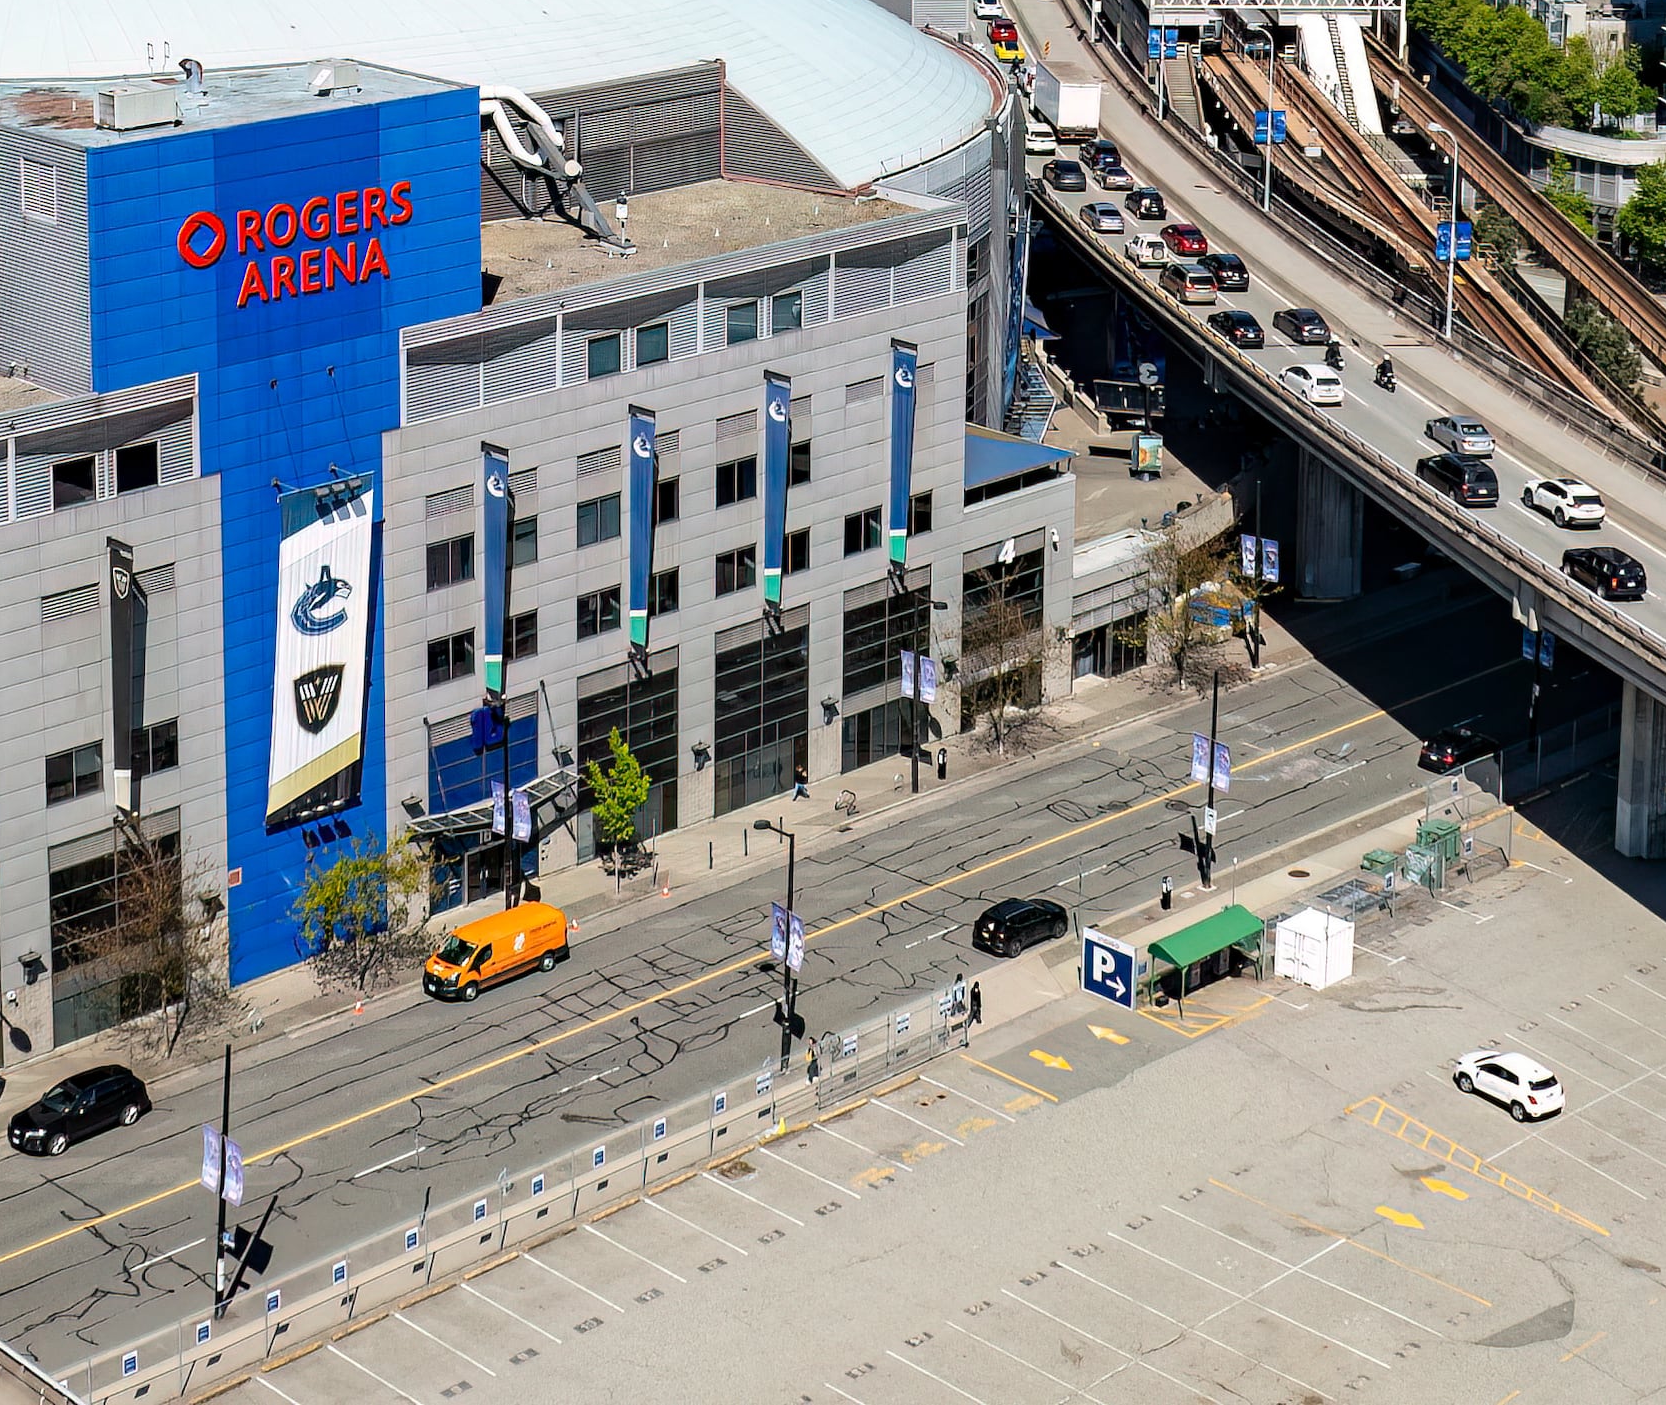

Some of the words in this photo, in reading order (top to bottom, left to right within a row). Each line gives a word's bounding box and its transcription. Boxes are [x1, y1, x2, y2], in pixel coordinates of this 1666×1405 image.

[235, 179, 414, 255] ROGERS
[235, 237, 391, 308] ARENA
[998, 538, 1016, 565] 4
[1092, 945, 1115, 982] P
